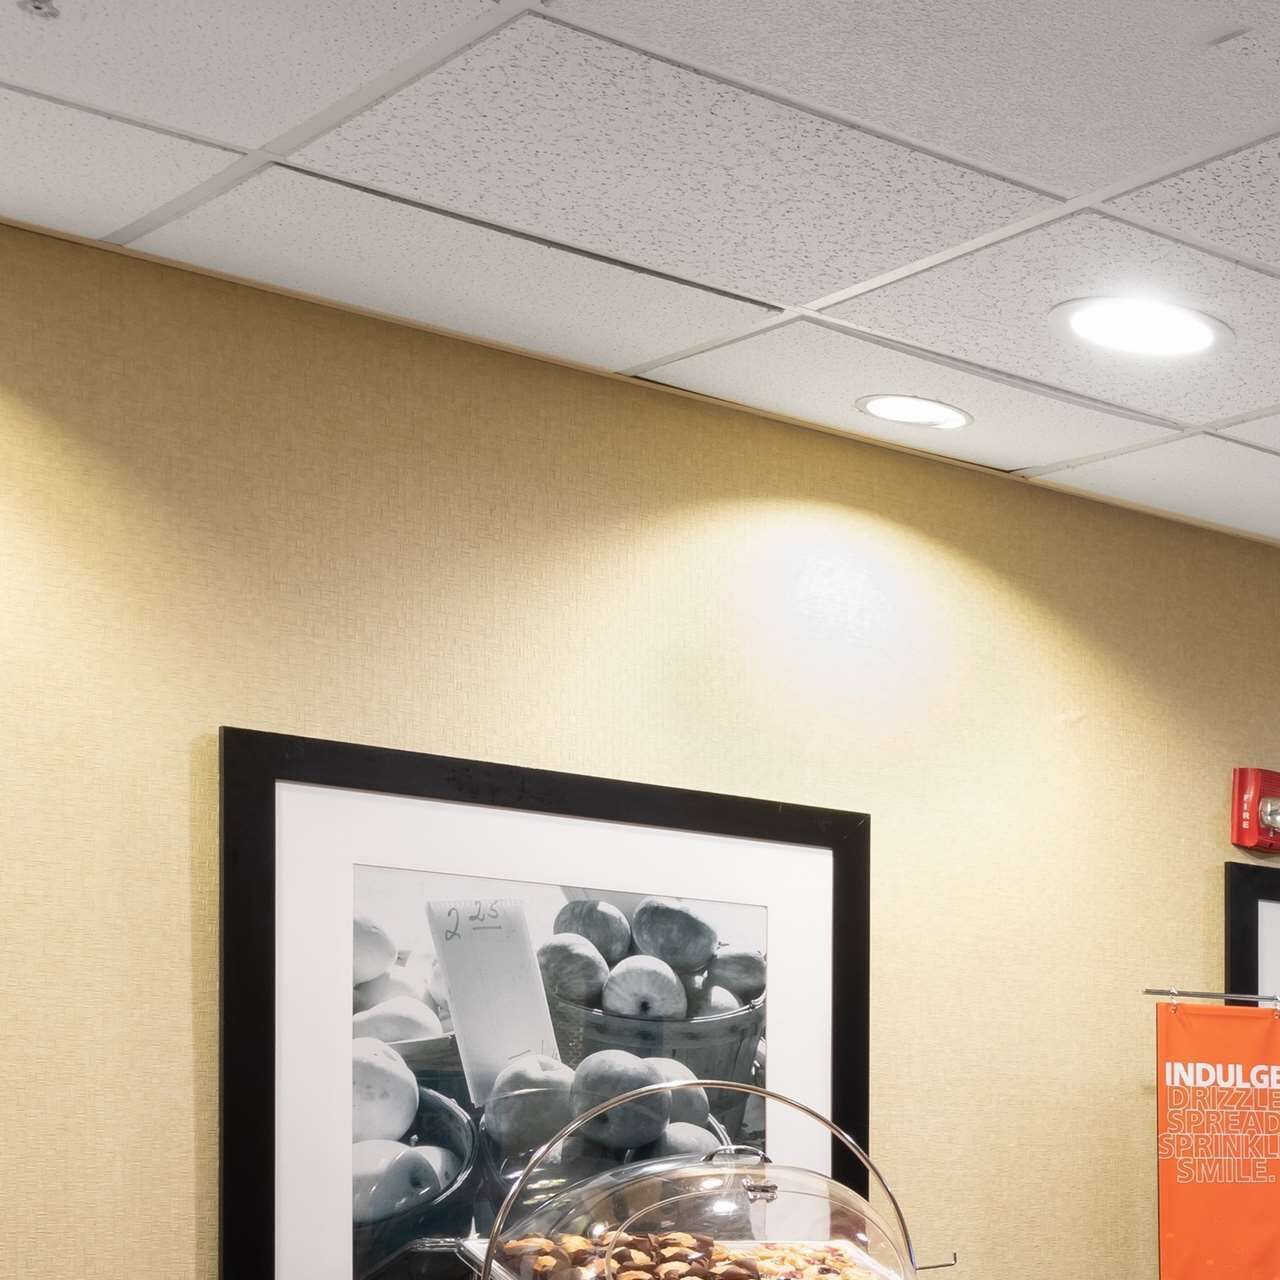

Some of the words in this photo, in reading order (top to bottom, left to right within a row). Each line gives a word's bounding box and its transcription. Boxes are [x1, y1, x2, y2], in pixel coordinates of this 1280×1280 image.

[1242, 794, 1251, 829] FIRE
[445, 908, 462, 941] 2
[1176, 1158, 1277, 1184] SMILE.
